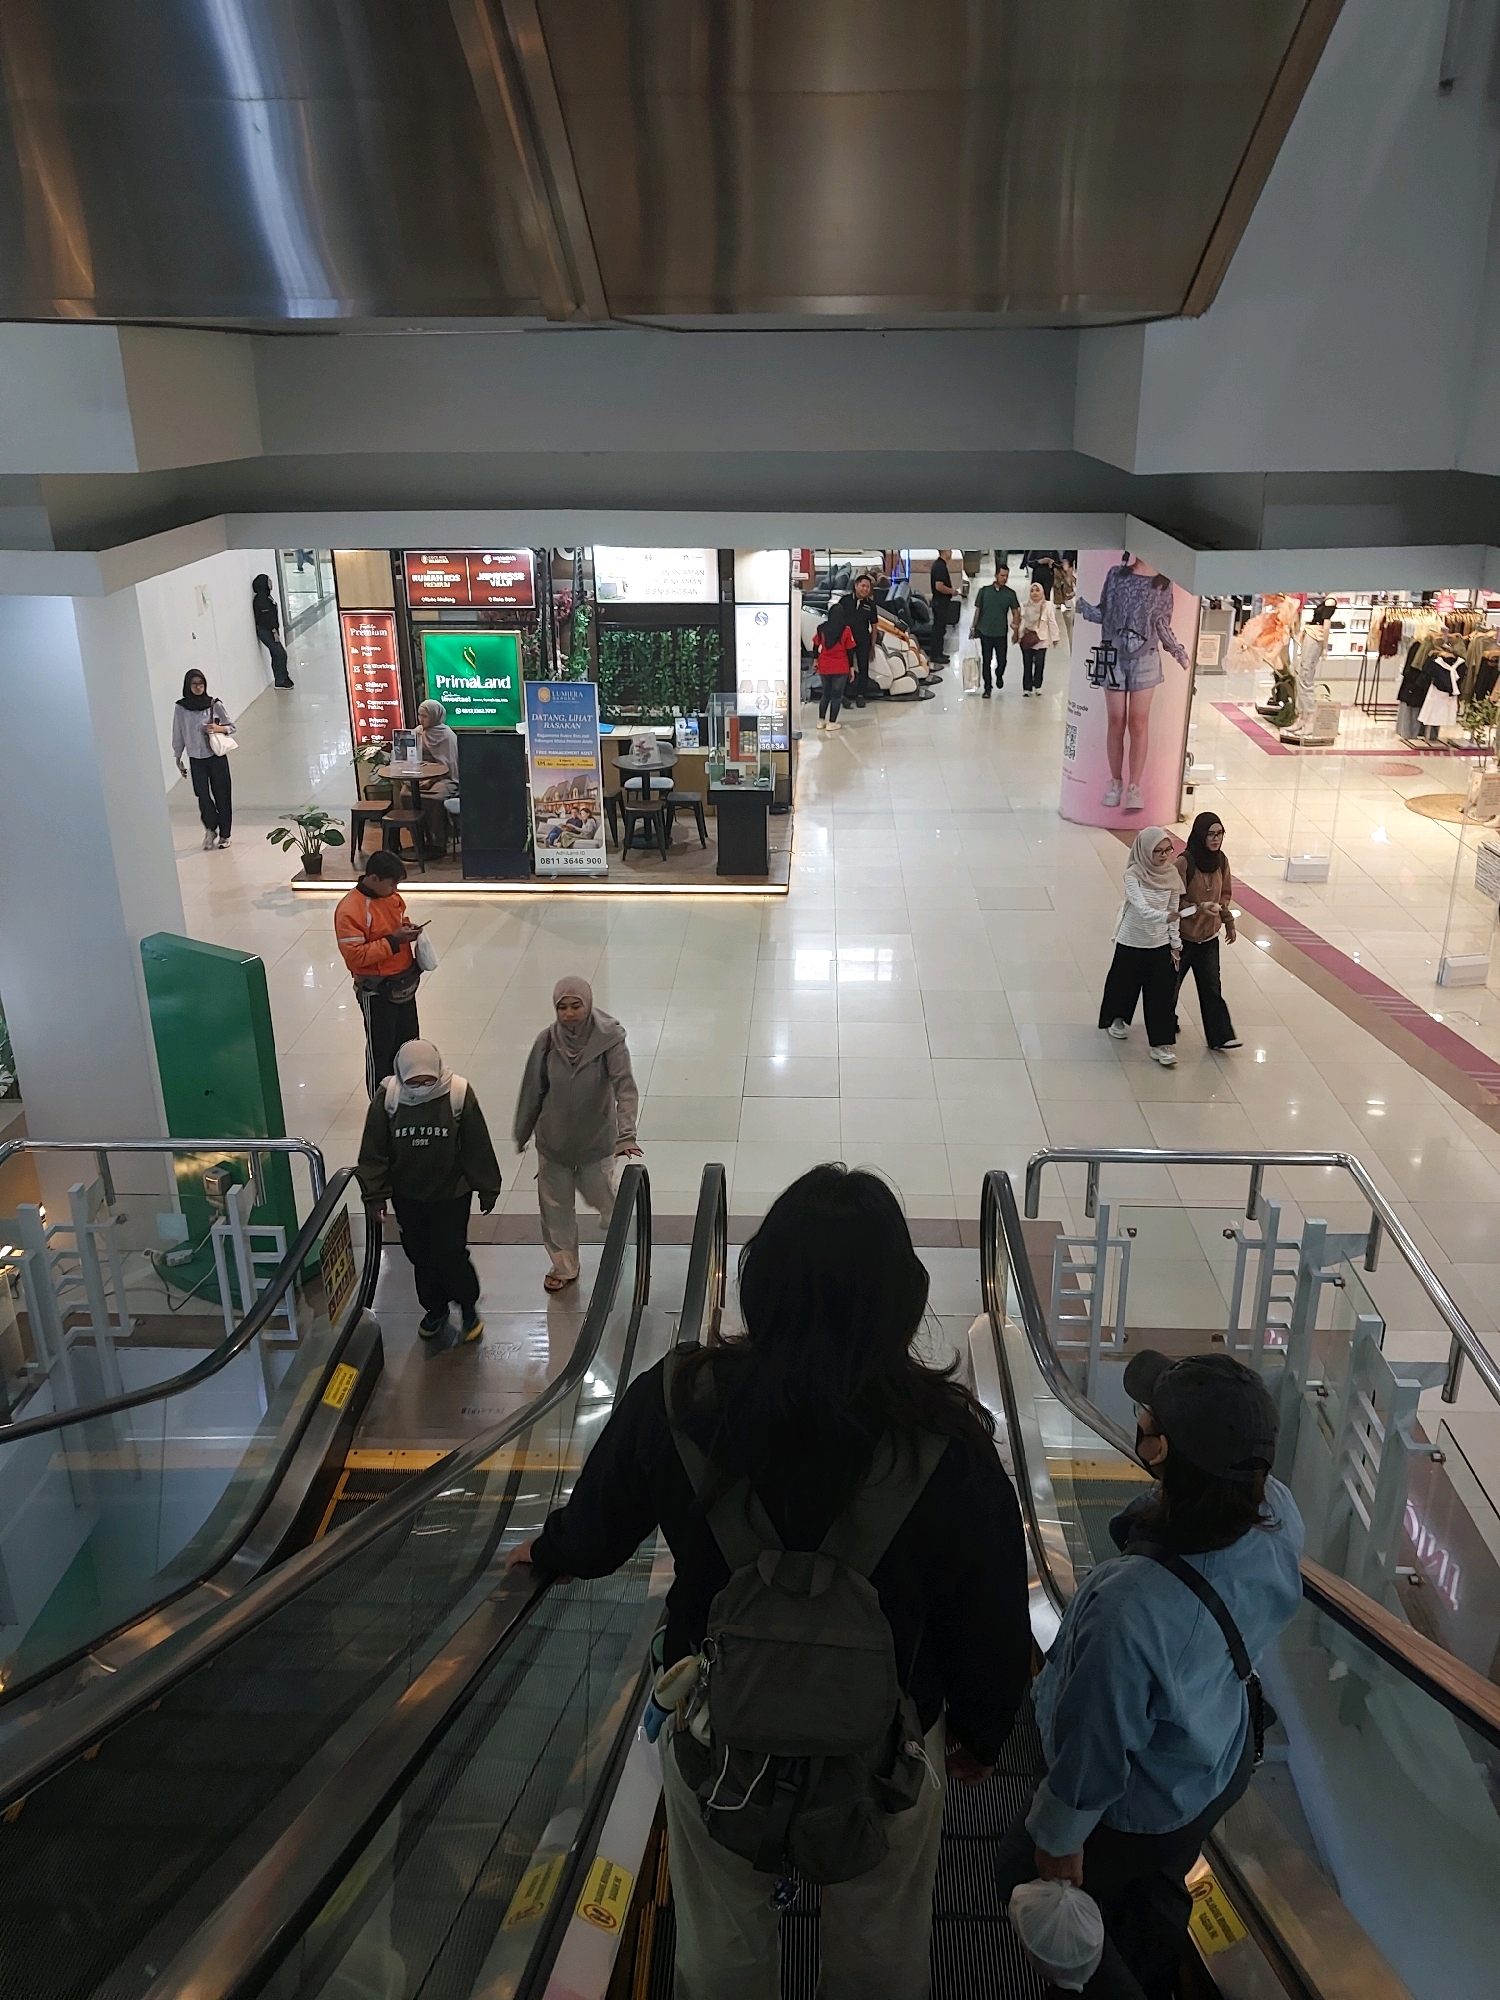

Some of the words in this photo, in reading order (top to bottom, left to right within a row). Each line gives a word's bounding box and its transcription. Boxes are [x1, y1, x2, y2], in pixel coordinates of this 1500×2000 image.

[350, 628, 388, 636] Premium
[436, 675, 511, 689] PrimaLand
[532, 713, 566, 722] DATANG,
[568, 714, 593, 722] LIHAT
[395, 1126, 416, 1138] NEW
[420, 1126, 449, 1137] YORK
